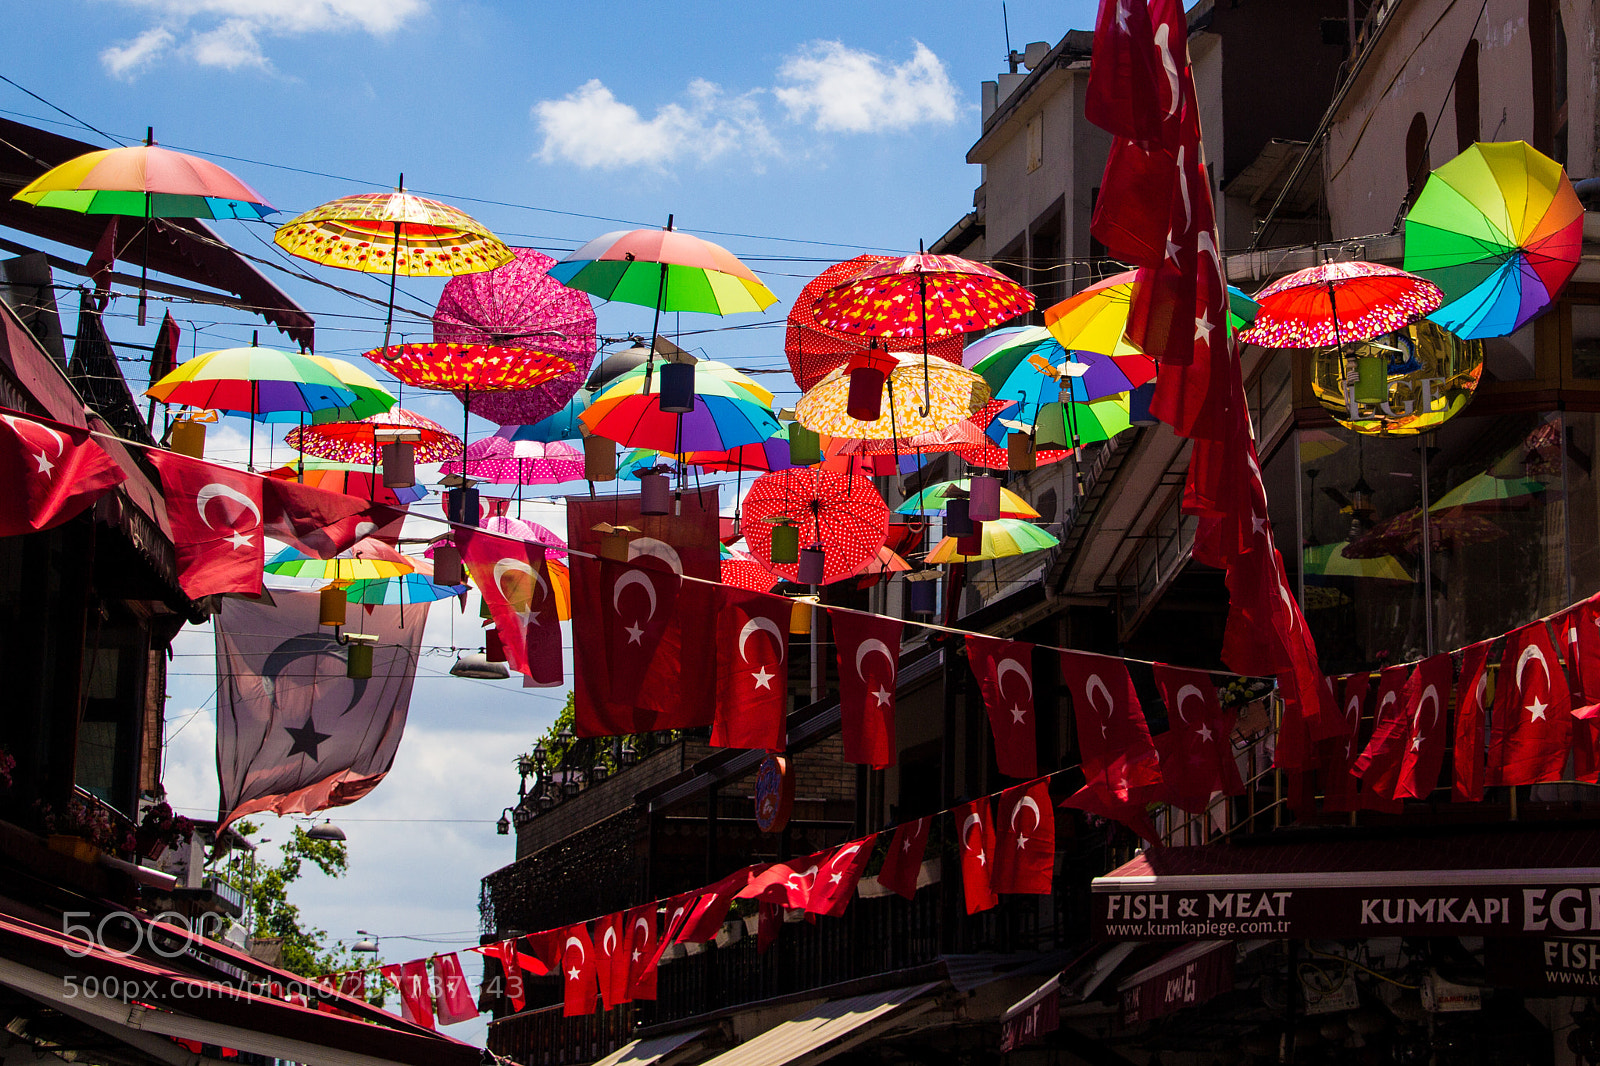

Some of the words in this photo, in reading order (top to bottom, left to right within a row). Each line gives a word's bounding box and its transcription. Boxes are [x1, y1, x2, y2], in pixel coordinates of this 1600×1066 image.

[1106, 894, 1170, 920] FISH
[1177, 897, 1200, 918] &
[1206, 891, 1294, 919] MEAT
[1360, 897, 1510, 925] KUMKAPI
[1106, 919, 1292, 937] www.kumkapiege.com.tr
